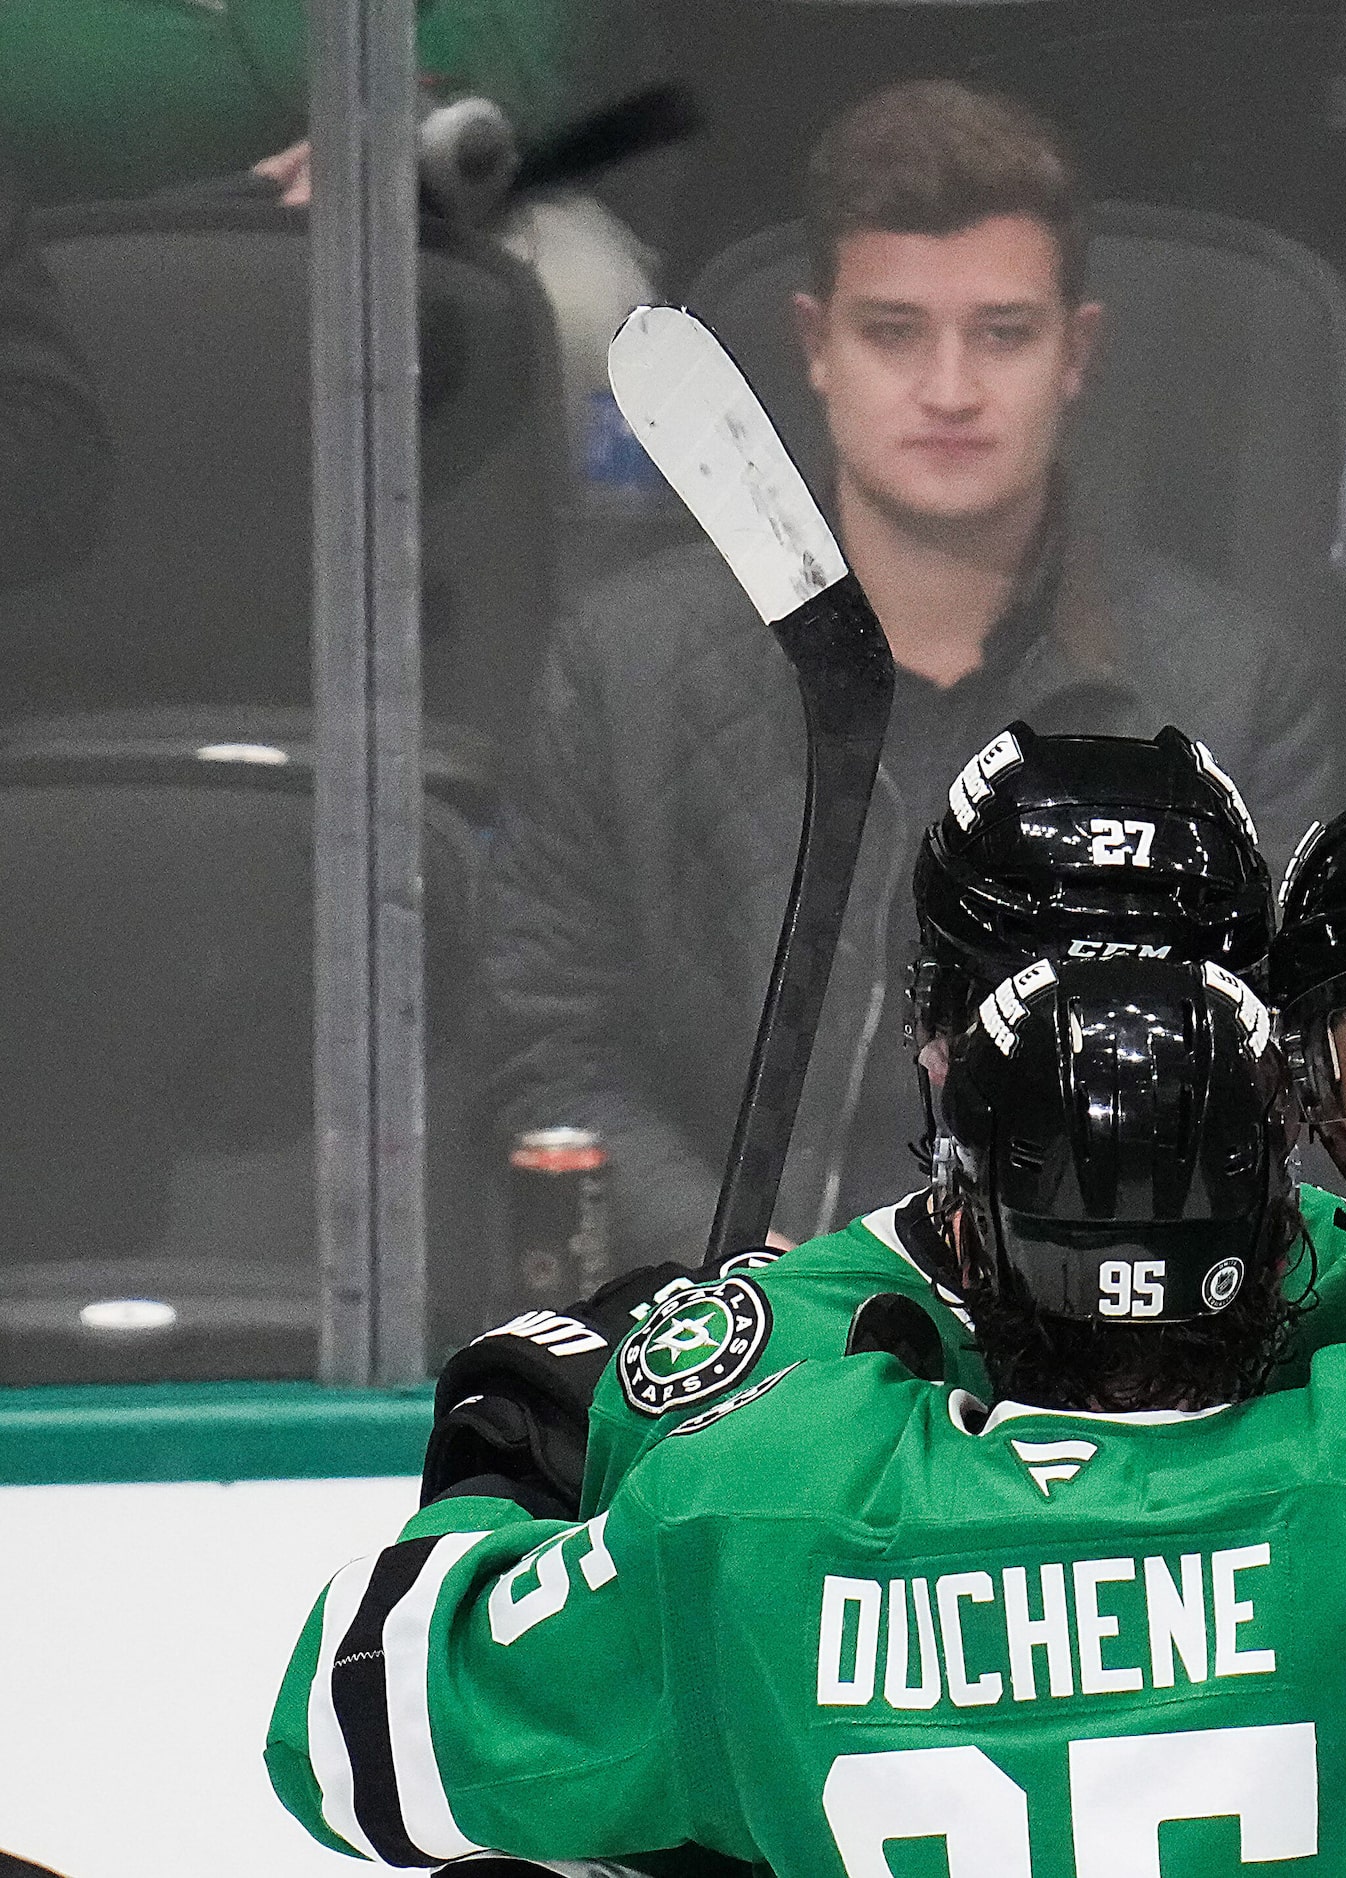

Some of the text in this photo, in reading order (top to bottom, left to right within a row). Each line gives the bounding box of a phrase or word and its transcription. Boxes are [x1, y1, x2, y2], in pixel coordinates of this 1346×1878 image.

[1090, 819, 1156, 868] 27
[1099, 1260, 1166, 1317] 95
[660, 1285, 753, 1355] DALLAS
[626, 1344, 702, 1402] STARS
[817, 1543, 1276, 1709] DUCHENE
